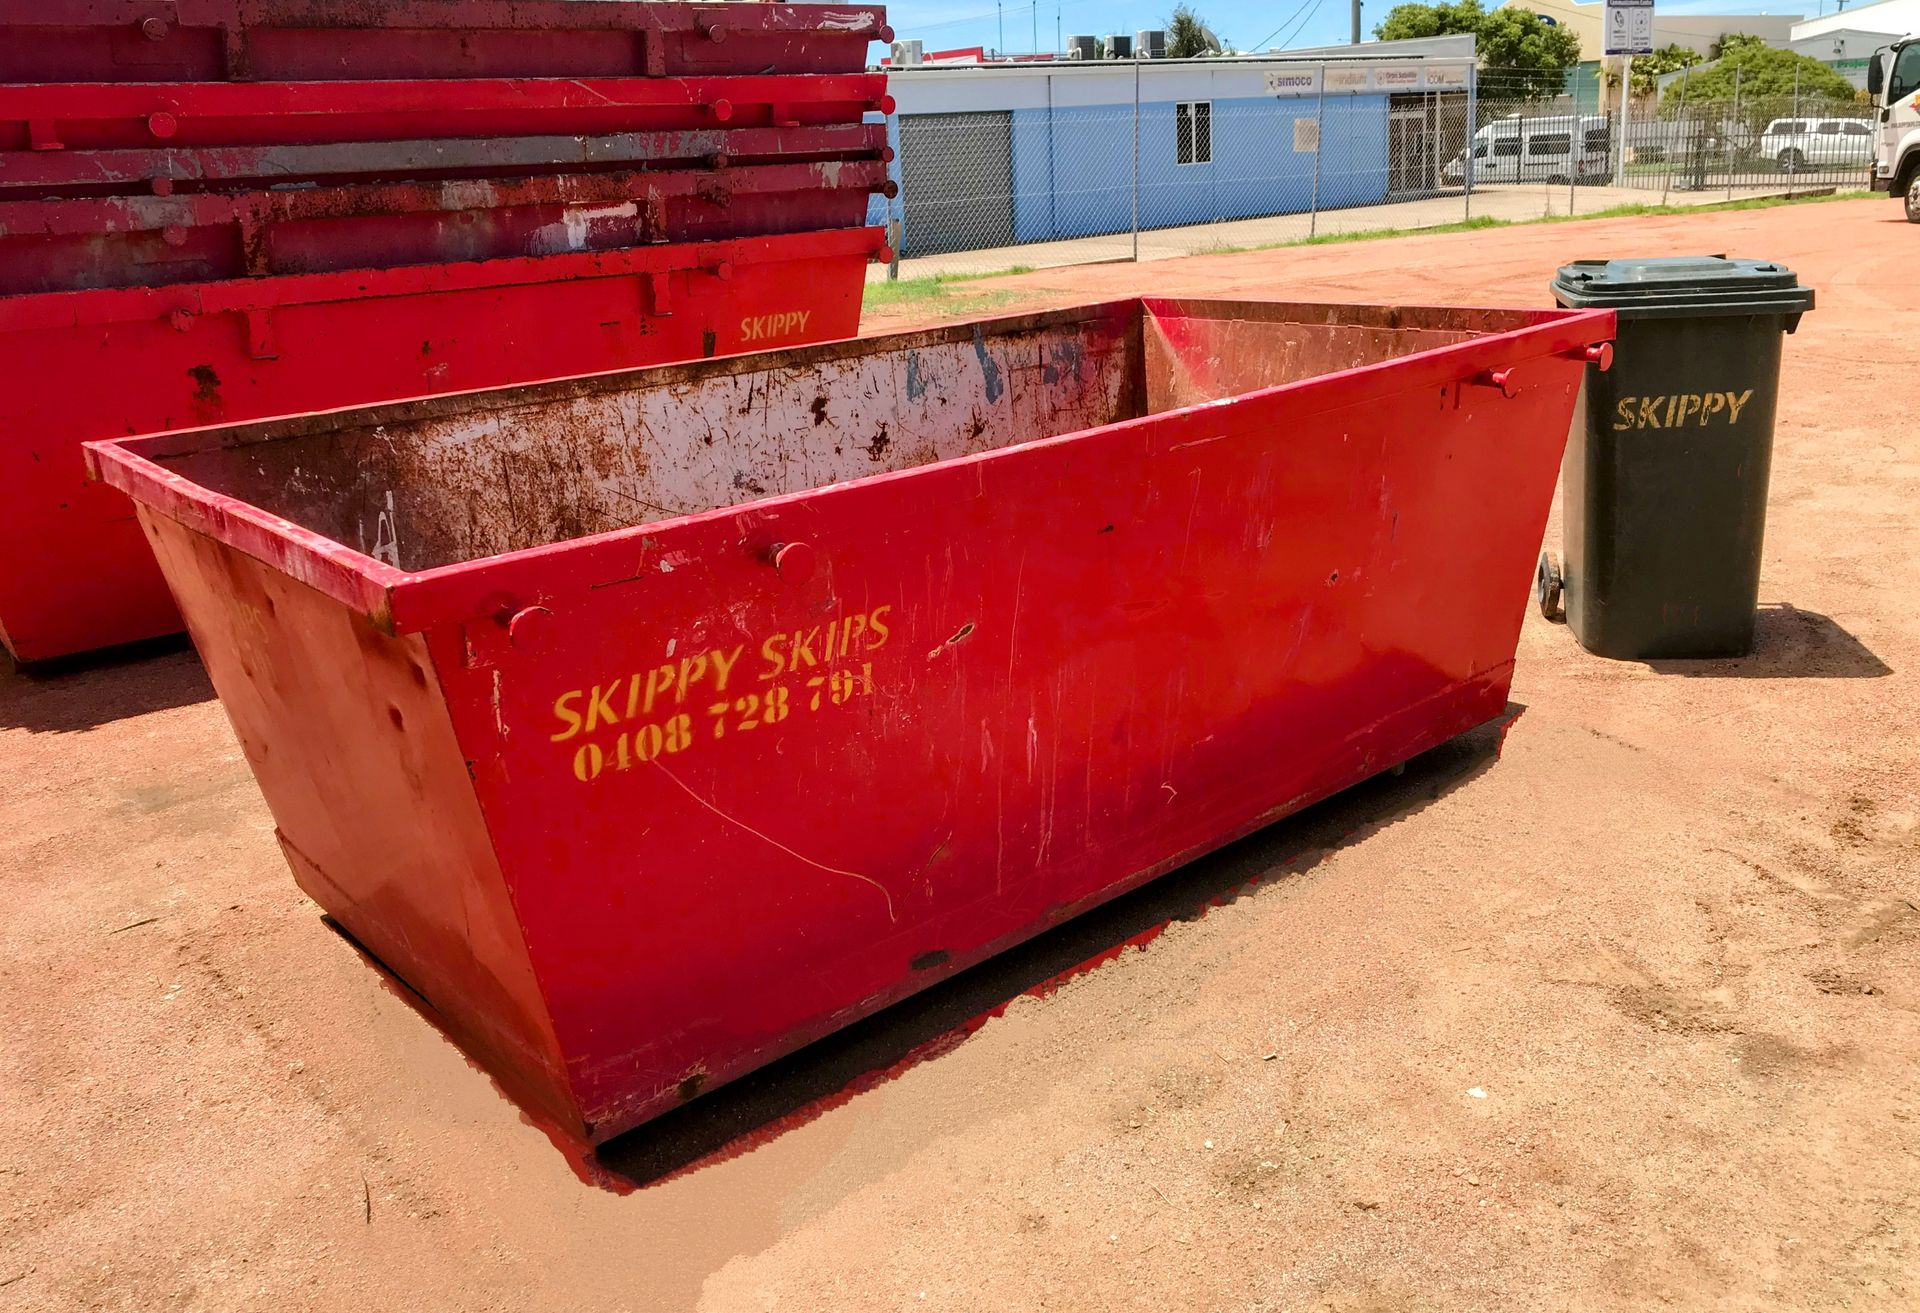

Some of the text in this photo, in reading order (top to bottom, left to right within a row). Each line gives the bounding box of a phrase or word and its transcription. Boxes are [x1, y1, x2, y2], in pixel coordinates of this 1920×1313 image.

[1277, 75, 1312, 87] simoco
[740, 310, 810, 341] SKIPPY
[1612, 389, 1754, 431] SKIPPY
[550, 604, 892, 742] SKIPPY SKIPS
[573, 662, 873, 782] 0408 728 791
